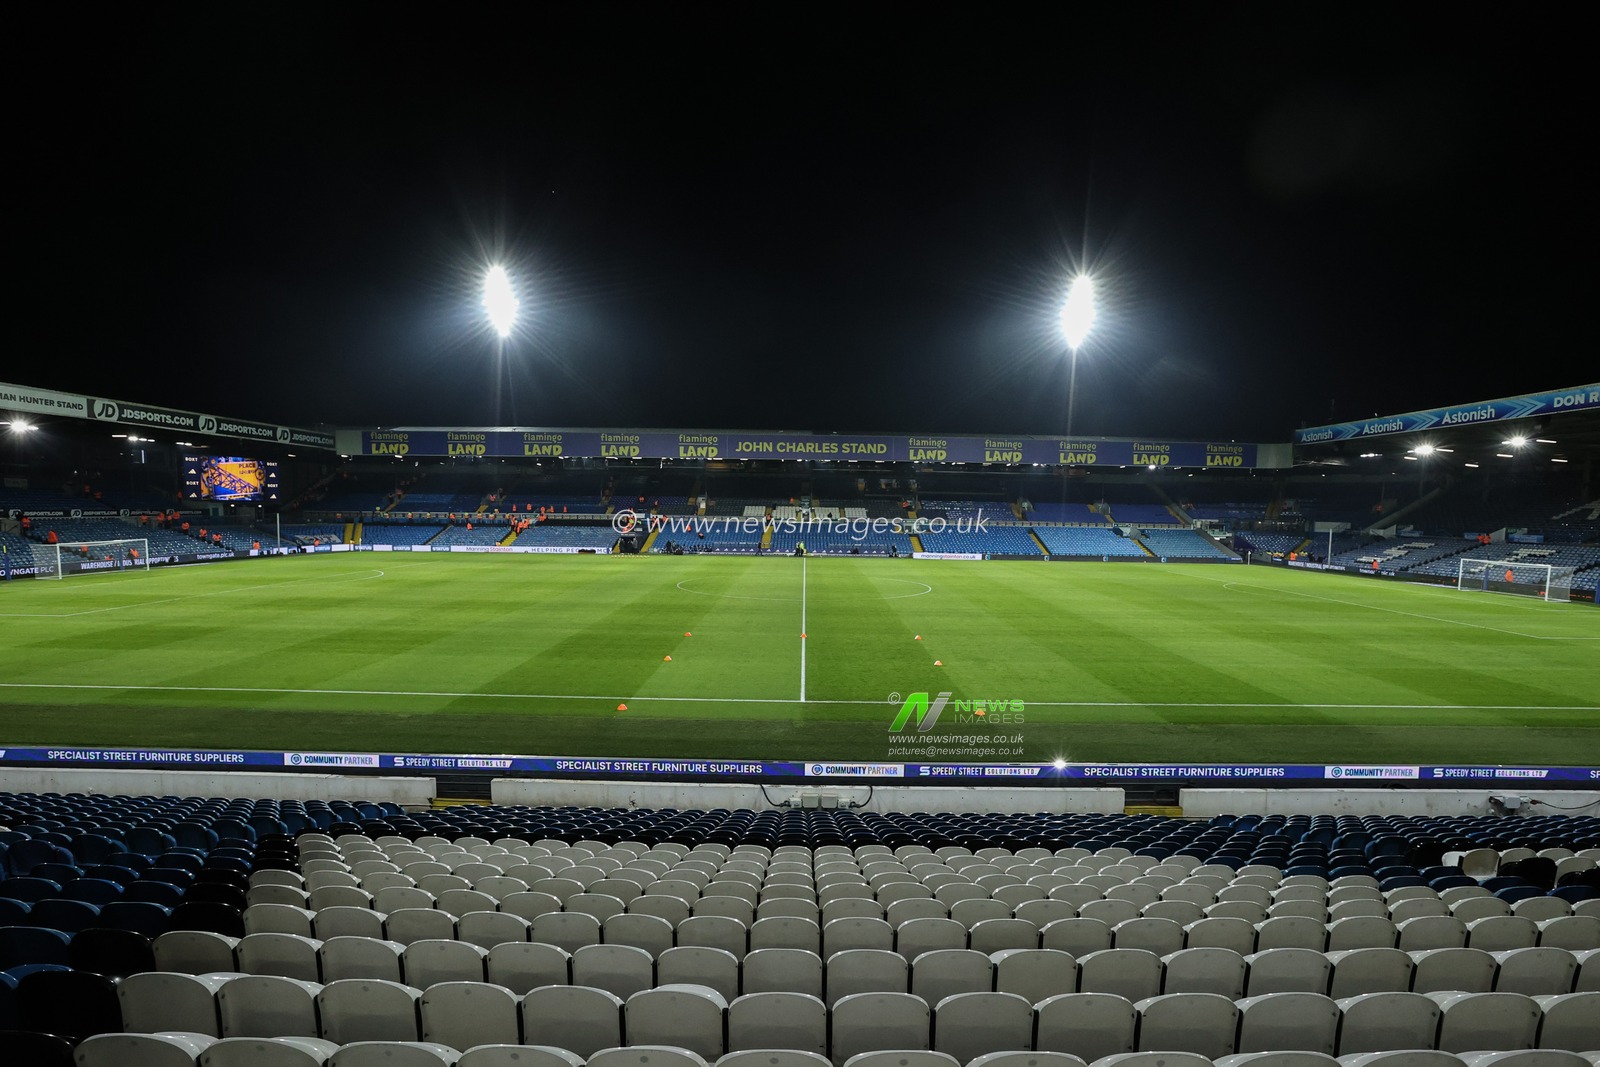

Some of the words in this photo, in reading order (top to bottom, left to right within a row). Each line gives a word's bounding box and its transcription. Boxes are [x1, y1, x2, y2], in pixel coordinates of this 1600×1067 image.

[0, 392, 17, 402] AN
[19, 395, 55, 407] HUNTER
[56, 400, 84, 410] STAND
[1553, 393, 1586, 408] DON
[97, 402, 117, 418] JD
[1441, 405, 1496, 425] Astonish
[121, 408, 194, 427] JDSPORTS.COM
[201, 418, 215, 431] JD
[219, 422, 273, 437] JDSPORTS.COM
[1362, 419, 1403, 435] Astonish
[278, 429, 290, 441] JD
[292, 433, 334, 446] JDSPORTS.COM
[370, 432, 409, 442] flamingo
[447, 432, 486, 442] flamingo
[523, 432, 562, 443] flamingo
[600, 433, 640, 443] flamingo
[678, 433, 718, 444] flamingo
[1301, 429, 1333, 442] Astonish
[735, 441, 774, 452] JOHN
[776, 442, 839, 453] CHARLES
[841, 443, 888, 454] STAND
[908, 437, 947, 448] flamingo
[984, 440, 1023, 450] flamingo
[1059, 441, 1097, 452] flamingo
[1133, 442, 1170, 453] flamingo
[371, 443, 409, 454] LAND
[447, 443, 486, 455] LAND
[524, 444, 563, 456] LAND
[601, 445, 640, 456] LAND
[679, 445, 718, 457] LAND
[1206, 444, 1243, 454] flamingo
[909, 449, 947, 460] LAND
[985, 451, 1023, 462] LAND
[1060, 452, 1096, 464] LAND
[1133, 454, 1170, 465] LAND
[1206, 455, 1243, 466] LAND
[40, 565, 55, 573] PLC
[81, 560, 113, 570] WAREHOUSE
[47, 751, 101, 760] SPECIALIST
[103, 751, 138, 761] STREET
[139, 752, 193, 762] FURNITURE
[194, 753, 245, 763] SUPPLIERS
[304, 755, 343, 765] COMMUNITY
[343, 756, 373, 766] PARTNER
[406, 757, 431, 767] SPEEDY
[431, 758, 456, 767] STREET
[556, 760, 612, 771] SPECIALIST
[614, 761, 650, 771] STREET
[652, 762, 708, 773] FURNITURE
[710, 763, 763, 774] SUPPLIERS
[825, 765, 867, 775] COMMUNITY
[867, 765, 898, 775] PARTNER
[932, 766, 957, 776] SPEEDY
[958, 766, 984, 776] STREET
[1084, 767, 1140, 777] SPECIALIST
[1141, 767, 1177, 777] STREET
[1178, 767, 1232, 777] FURNITURE
[1234, 767, 1285, 778] SUPPLIERS
[1345, 768, 1384, 778] COMMUNITY
[1384, 768, 1413, 777] PARTNER
[1445, 768, 1469, 778] SPEEDY
[1470, 768, 1494, 778] STREET
